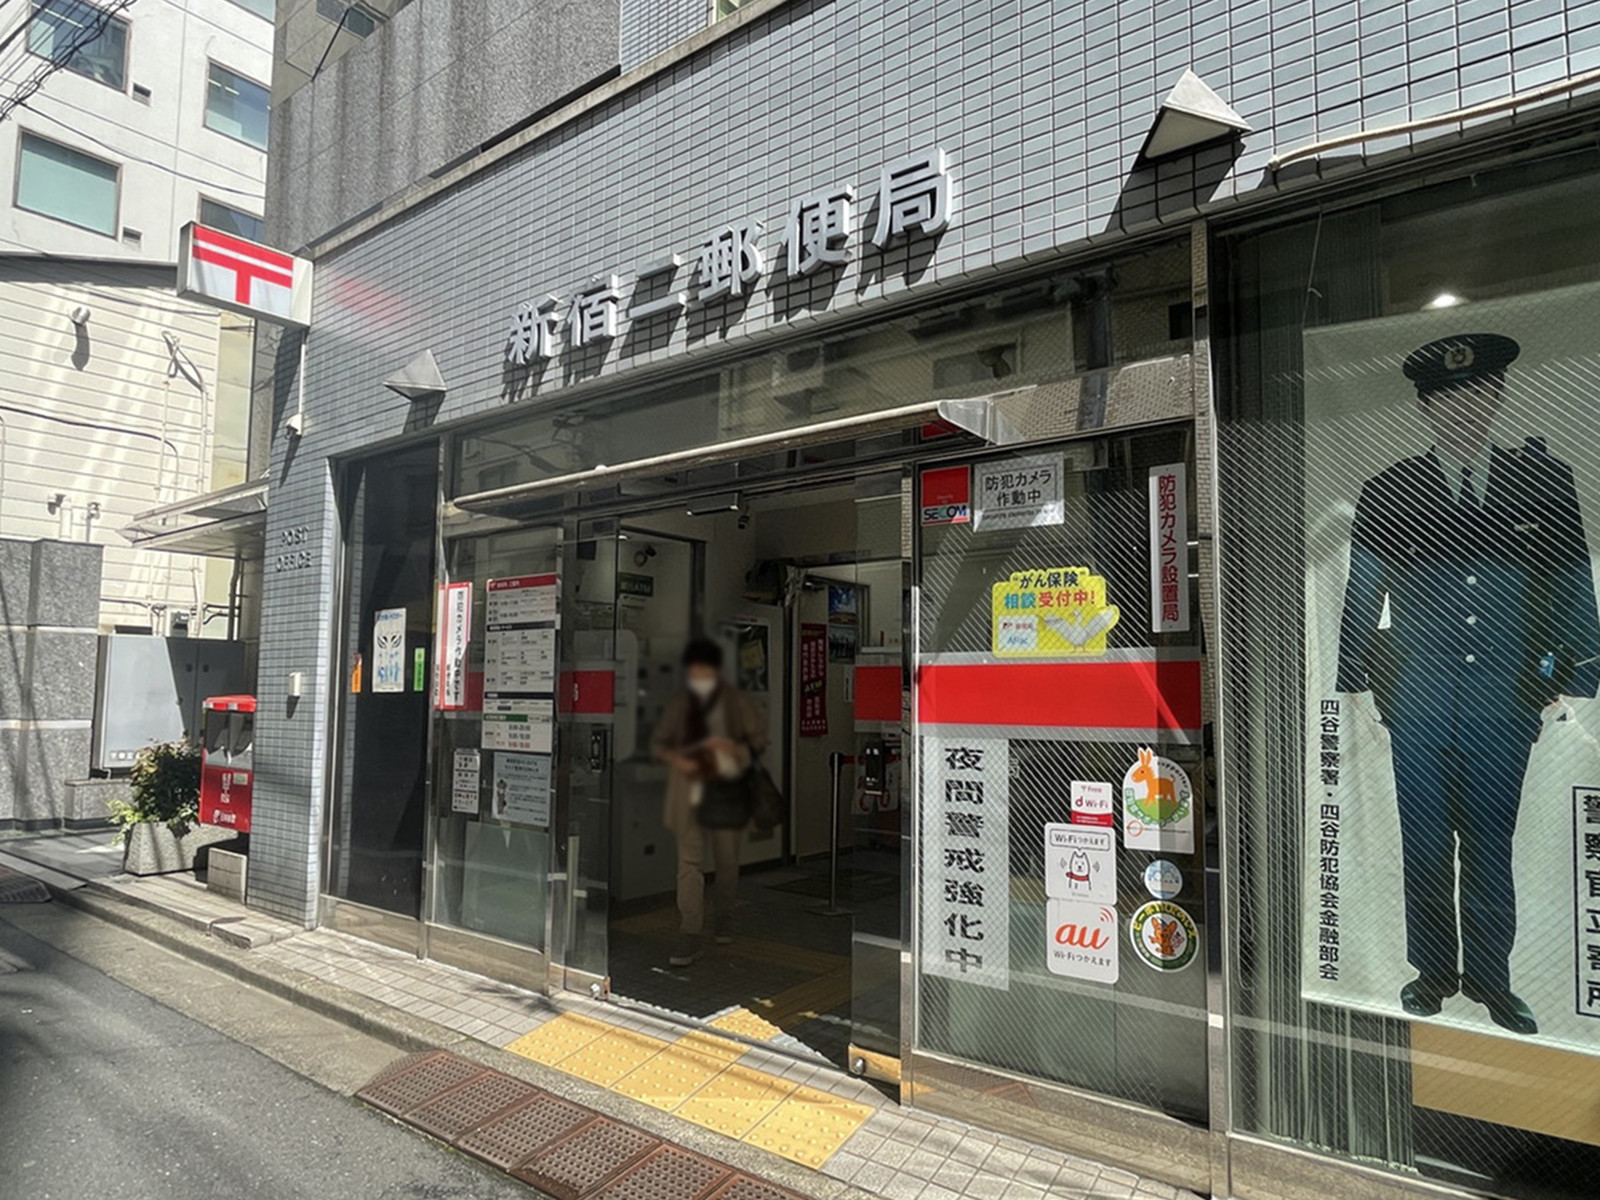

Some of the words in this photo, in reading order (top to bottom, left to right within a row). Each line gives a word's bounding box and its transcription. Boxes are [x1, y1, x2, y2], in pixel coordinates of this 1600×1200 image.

[506, 148, 953, 364] 新宿二郵便局
[985, 470, 1052, 491] 防犯カメラ
[997, 489, 1041, 506] 作動中
[924, 505, 967, 520] SECOM
[280, 526, 310, 547] POST
[1158, 474, 1179, 622] 防犯カメラ設置局
[276, 551, 312, 572] OFFICE
[943, 746, 986, 974] 夜間警戒強化中
[1055, 924, 1110, 950] au
